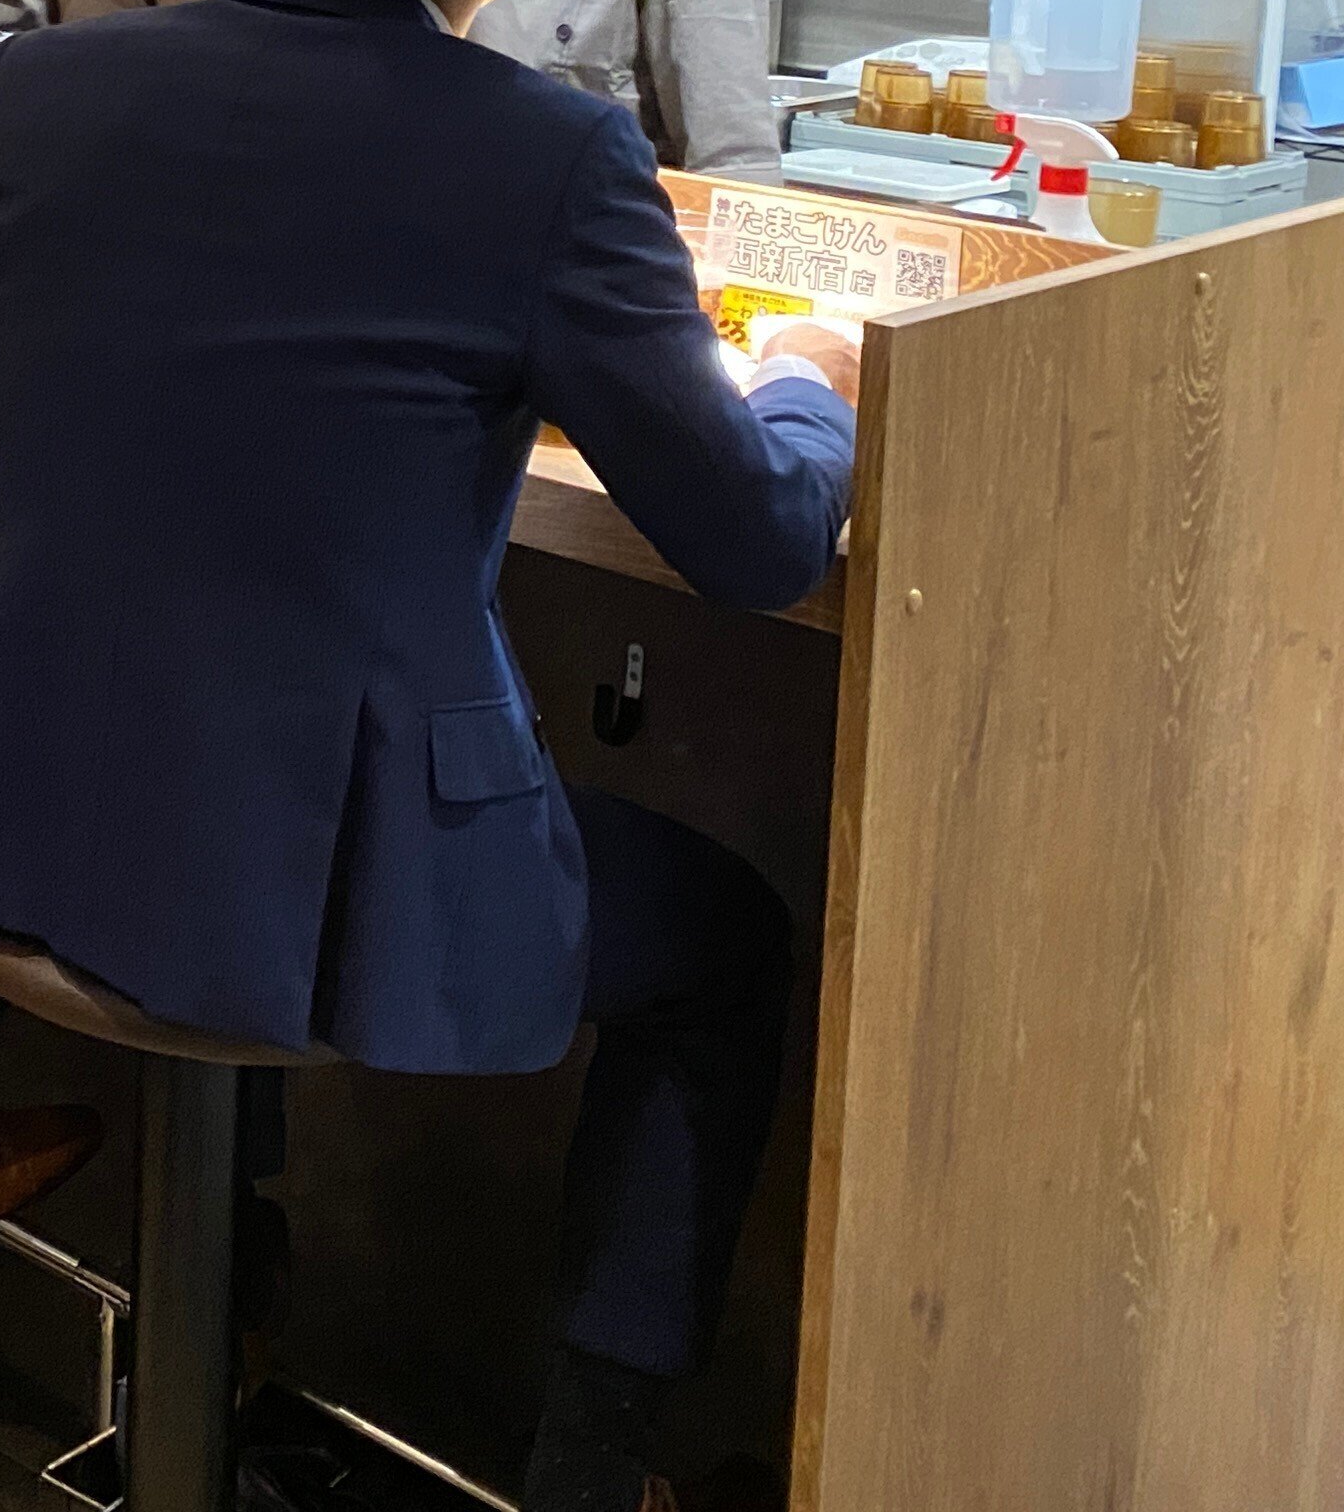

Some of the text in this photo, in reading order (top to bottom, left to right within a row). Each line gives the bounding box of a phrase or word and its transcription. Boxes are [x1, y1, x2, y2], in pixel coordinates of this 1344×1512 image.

[734, 200, 887, 256] たまごけん
